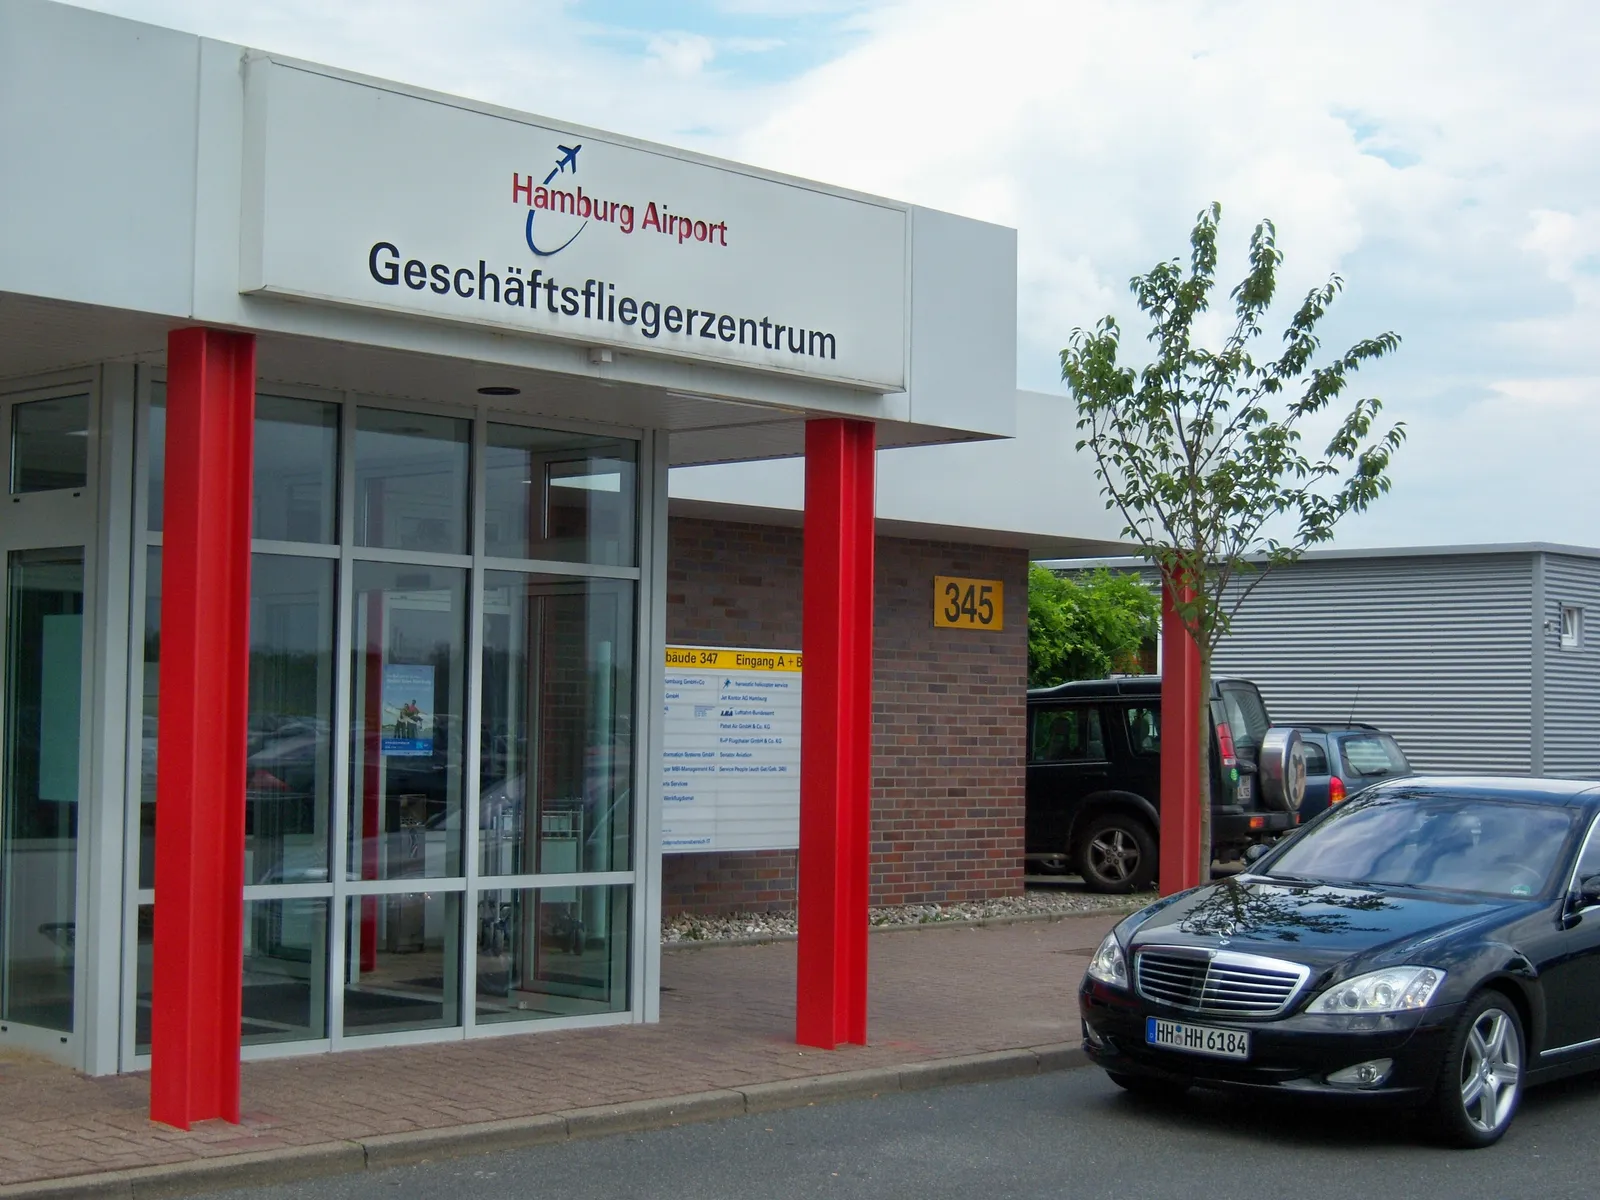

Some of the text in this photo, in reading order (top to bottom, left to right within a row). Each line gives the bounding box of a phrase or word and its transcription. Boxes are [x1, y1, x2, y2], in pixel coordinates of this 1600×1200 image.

[512, 173, 728, 247] Hamburg Airport
[369, 241, 836, 359] Geschäftsfliegerzentrum
[945, 583, 993, 624] 345
[700, 652, 718, 664] 347
[736, 654, 774, 669] Eingang
[777, 656, 785, 667] A
[796, 657, 802, 668] B
[1157, 1023, 1246, 1054] HH HH 6184
